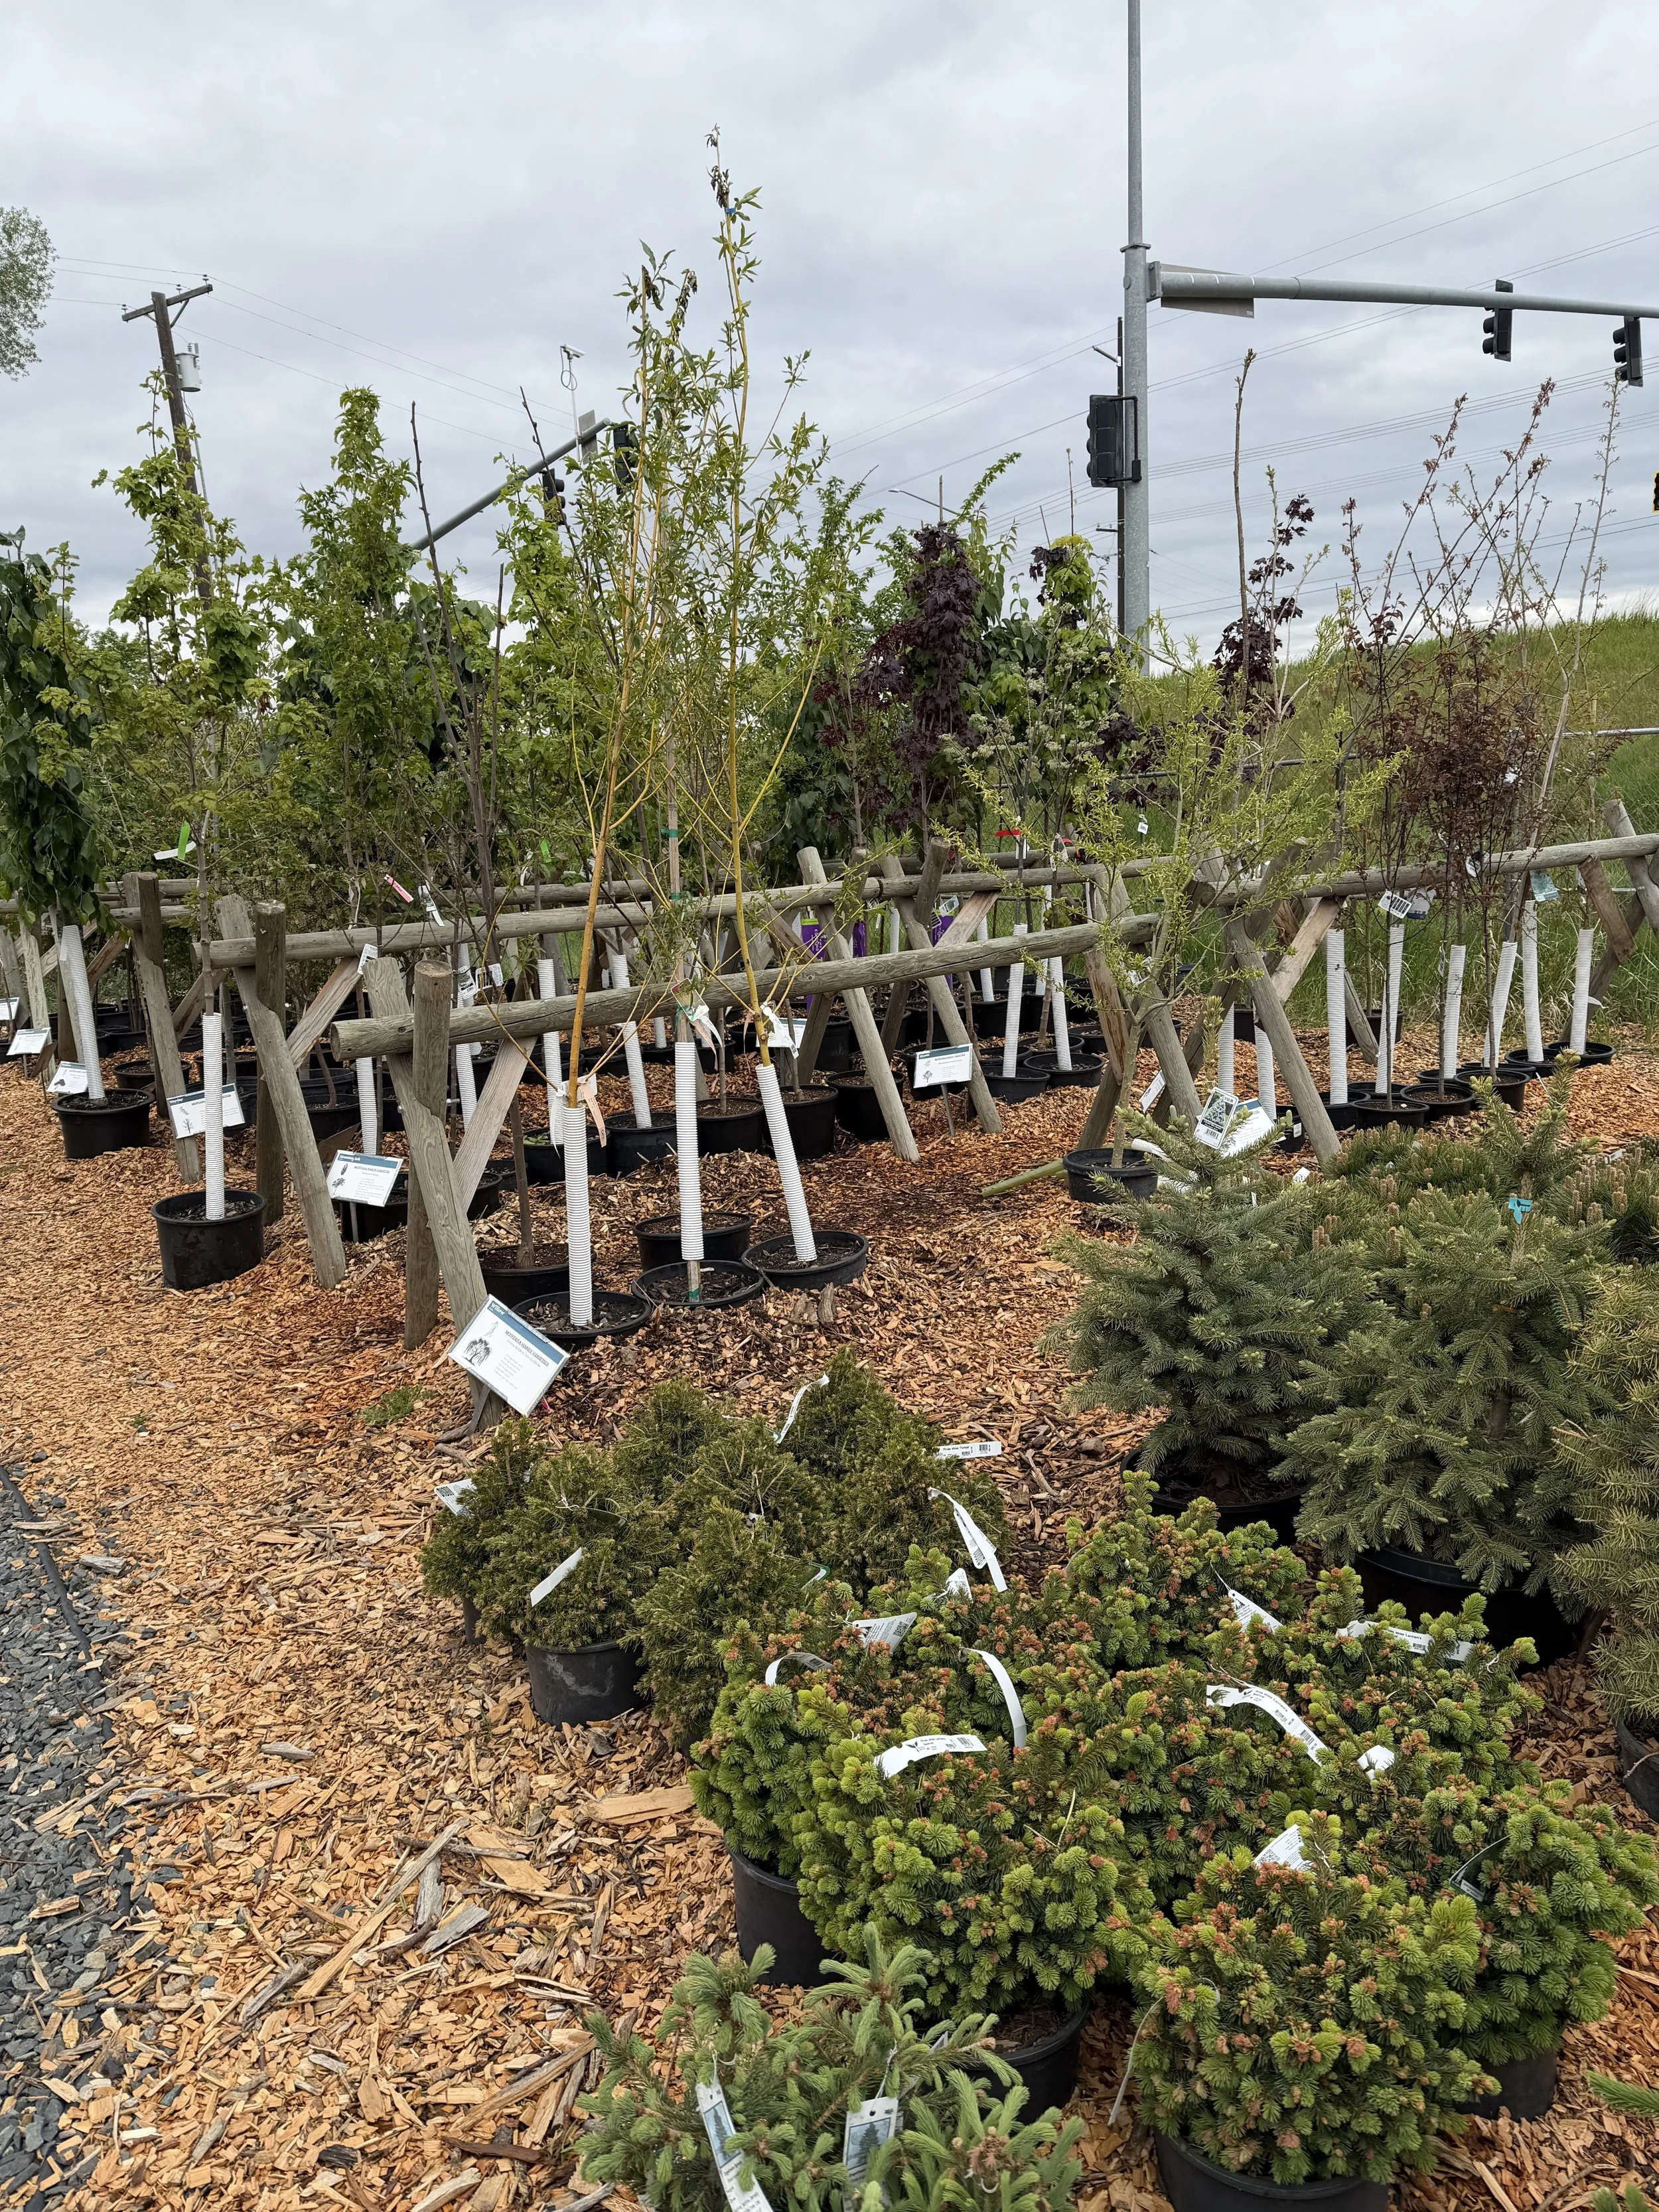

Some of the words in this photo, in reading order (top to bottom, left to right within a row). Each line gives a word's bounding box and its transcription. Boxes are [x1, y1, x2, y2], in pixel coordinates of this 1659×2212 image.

[491, 1302, 505, 1315] Willow
[505, 1330, 522, 1346] MONTANA
[520, 1342, 533, 1354] HARDY
[532, 1351, 549, 1367] VARIETIES
